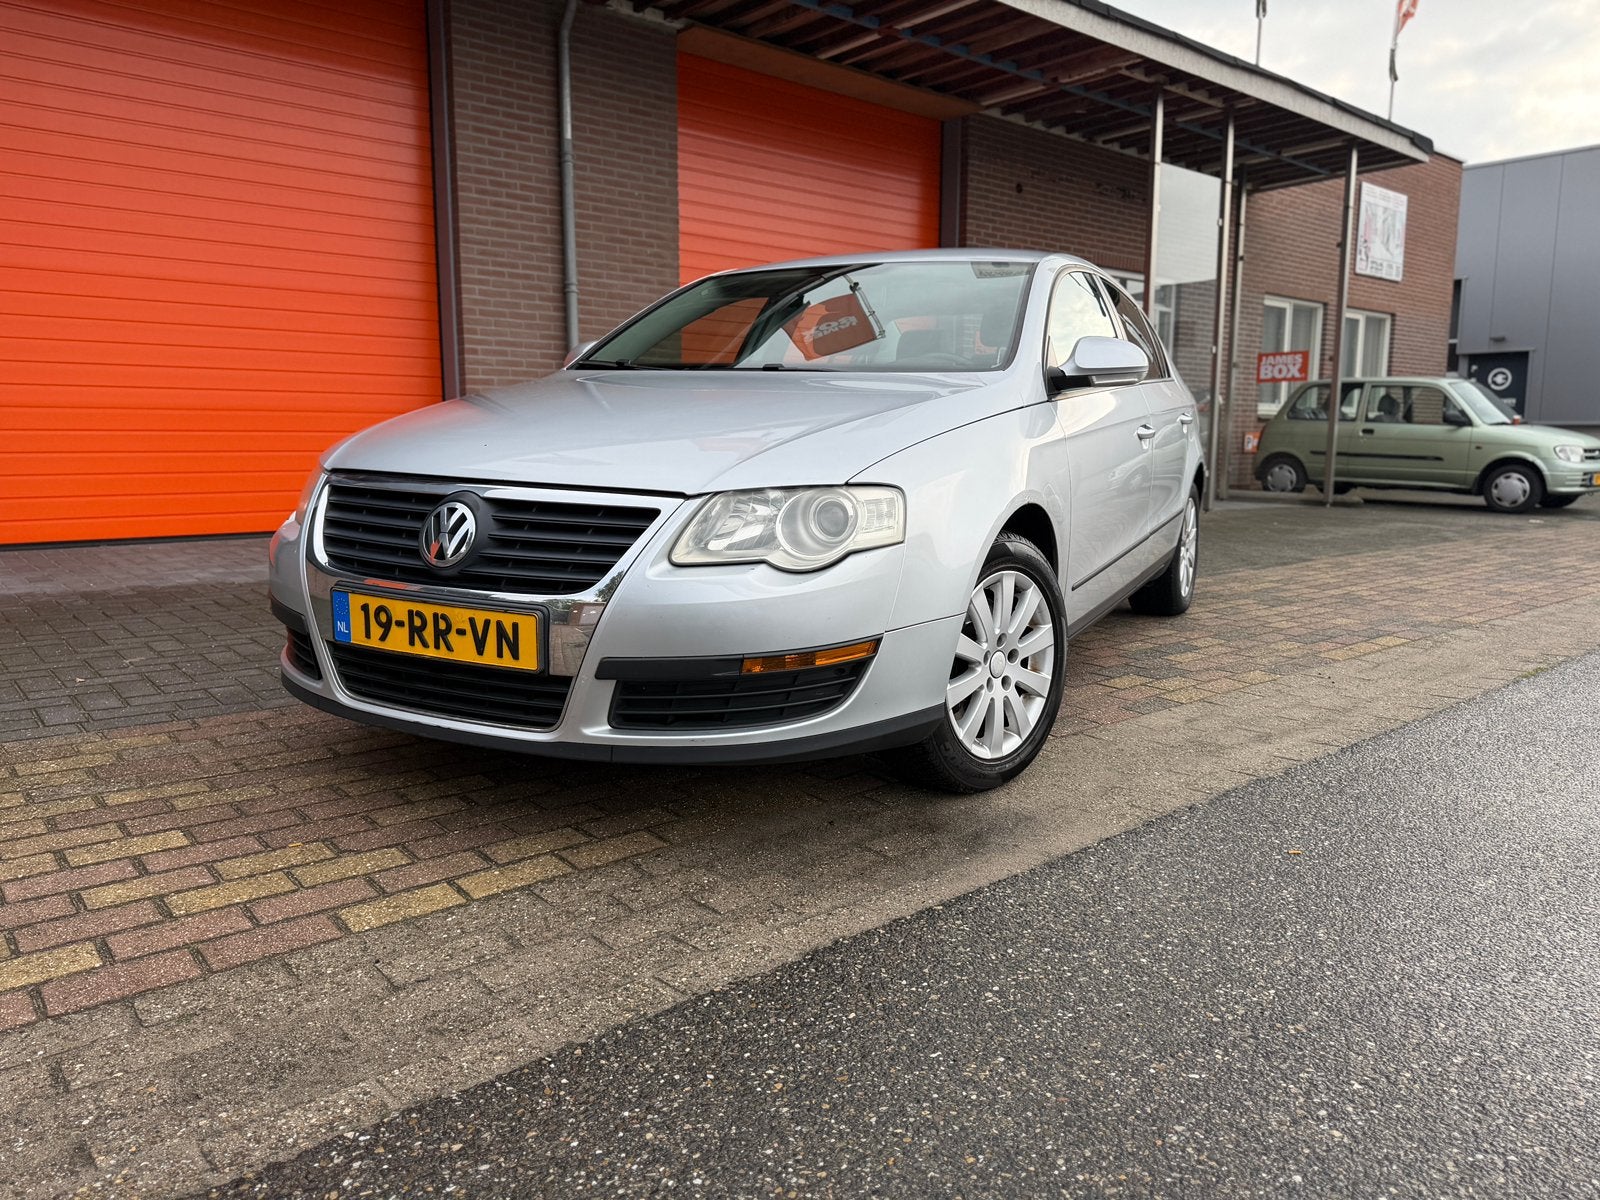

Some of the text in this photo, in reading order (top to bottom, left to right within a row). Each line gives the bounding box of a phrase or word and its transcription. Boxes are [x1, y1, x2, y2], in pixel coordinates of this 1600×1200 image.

[1261, 354, 1303, 365] JAMES
[1260, 363, 1303, 379] BOX
[337, 620, 349, 633] NL
[360, 602, 520, 661] 19-RR-VN
